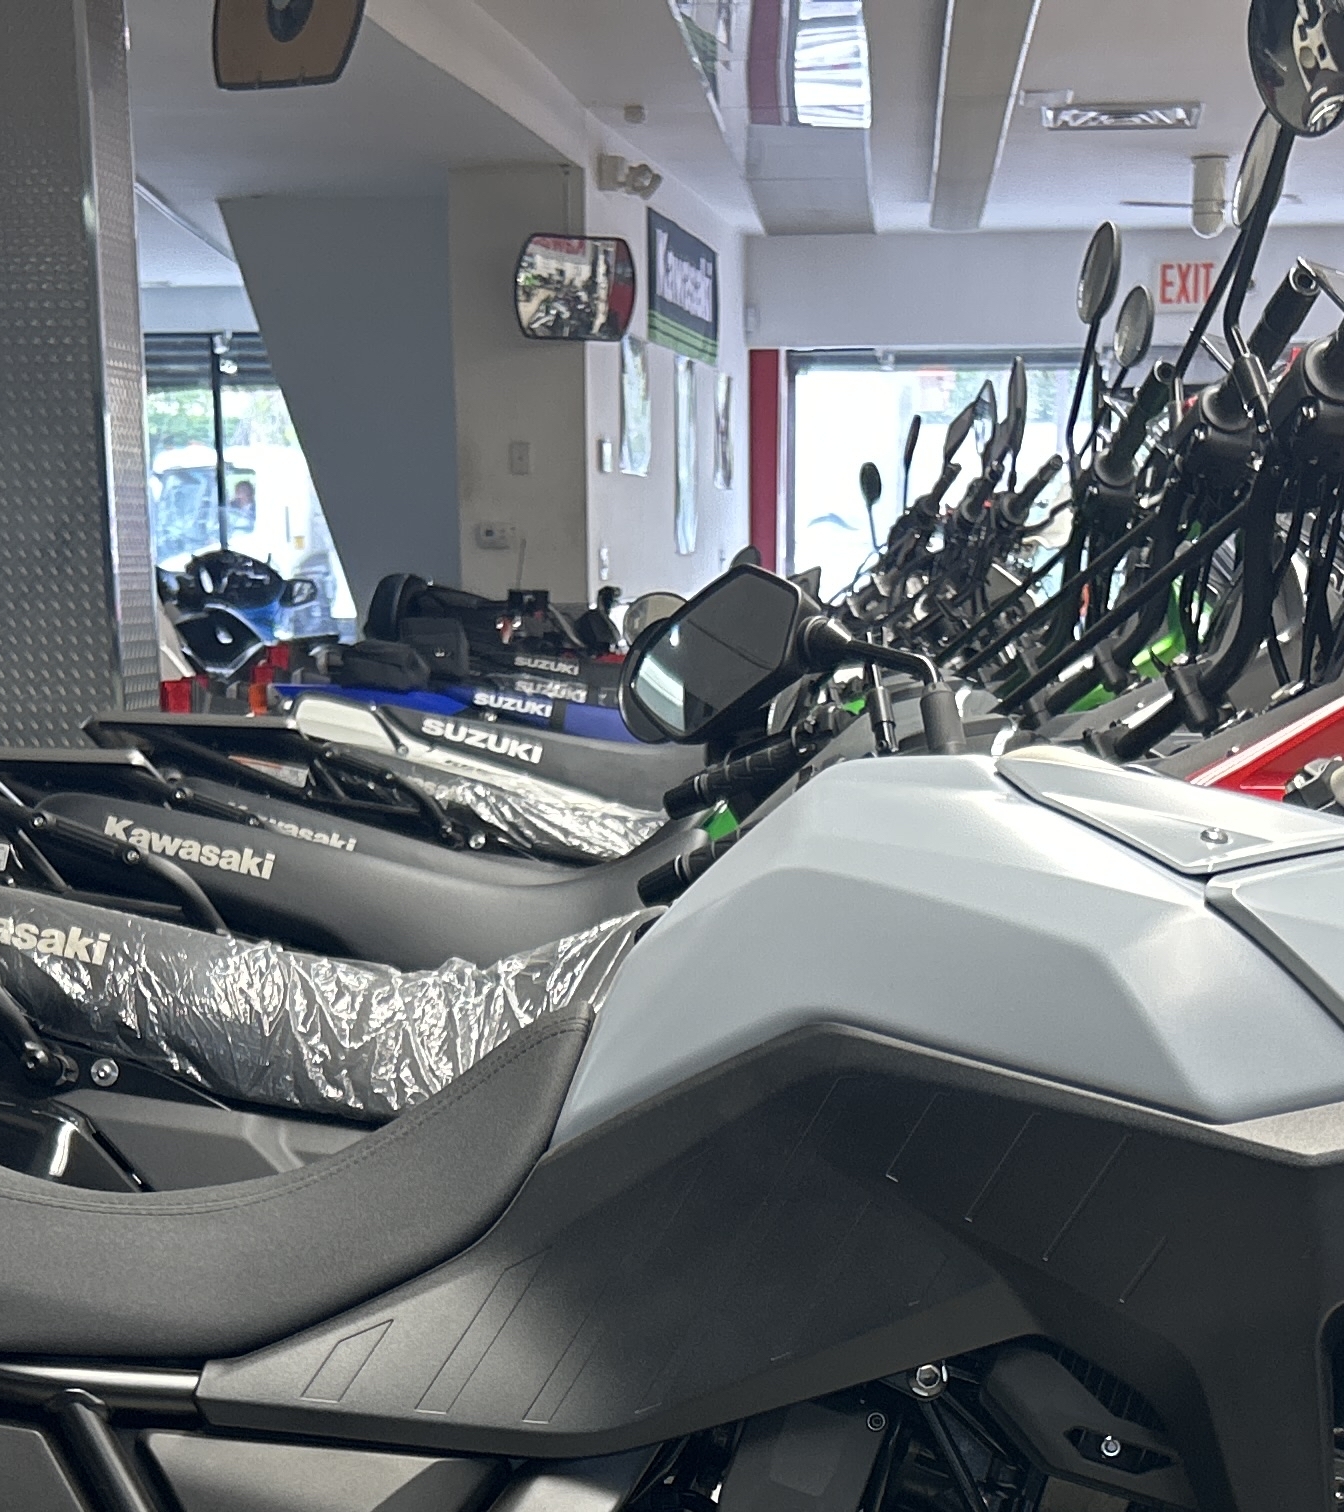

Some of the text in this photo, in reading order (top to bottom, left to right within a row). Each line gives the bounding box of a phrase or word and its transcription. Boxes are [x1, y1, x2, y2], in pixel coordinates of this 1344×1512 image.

[655, 228, 713, 323] Kawasaki
[1160, 262, 1215, 304] EXIT
[514, 656, 579, 676] SUZUKI
[472, 692, 554, 718] SUZUKI
[515, 680, 587, 704] SUZUKI
[421, 718, 543, 765] SUZUKI
[104, 815, 276, 880] Kawasaki
